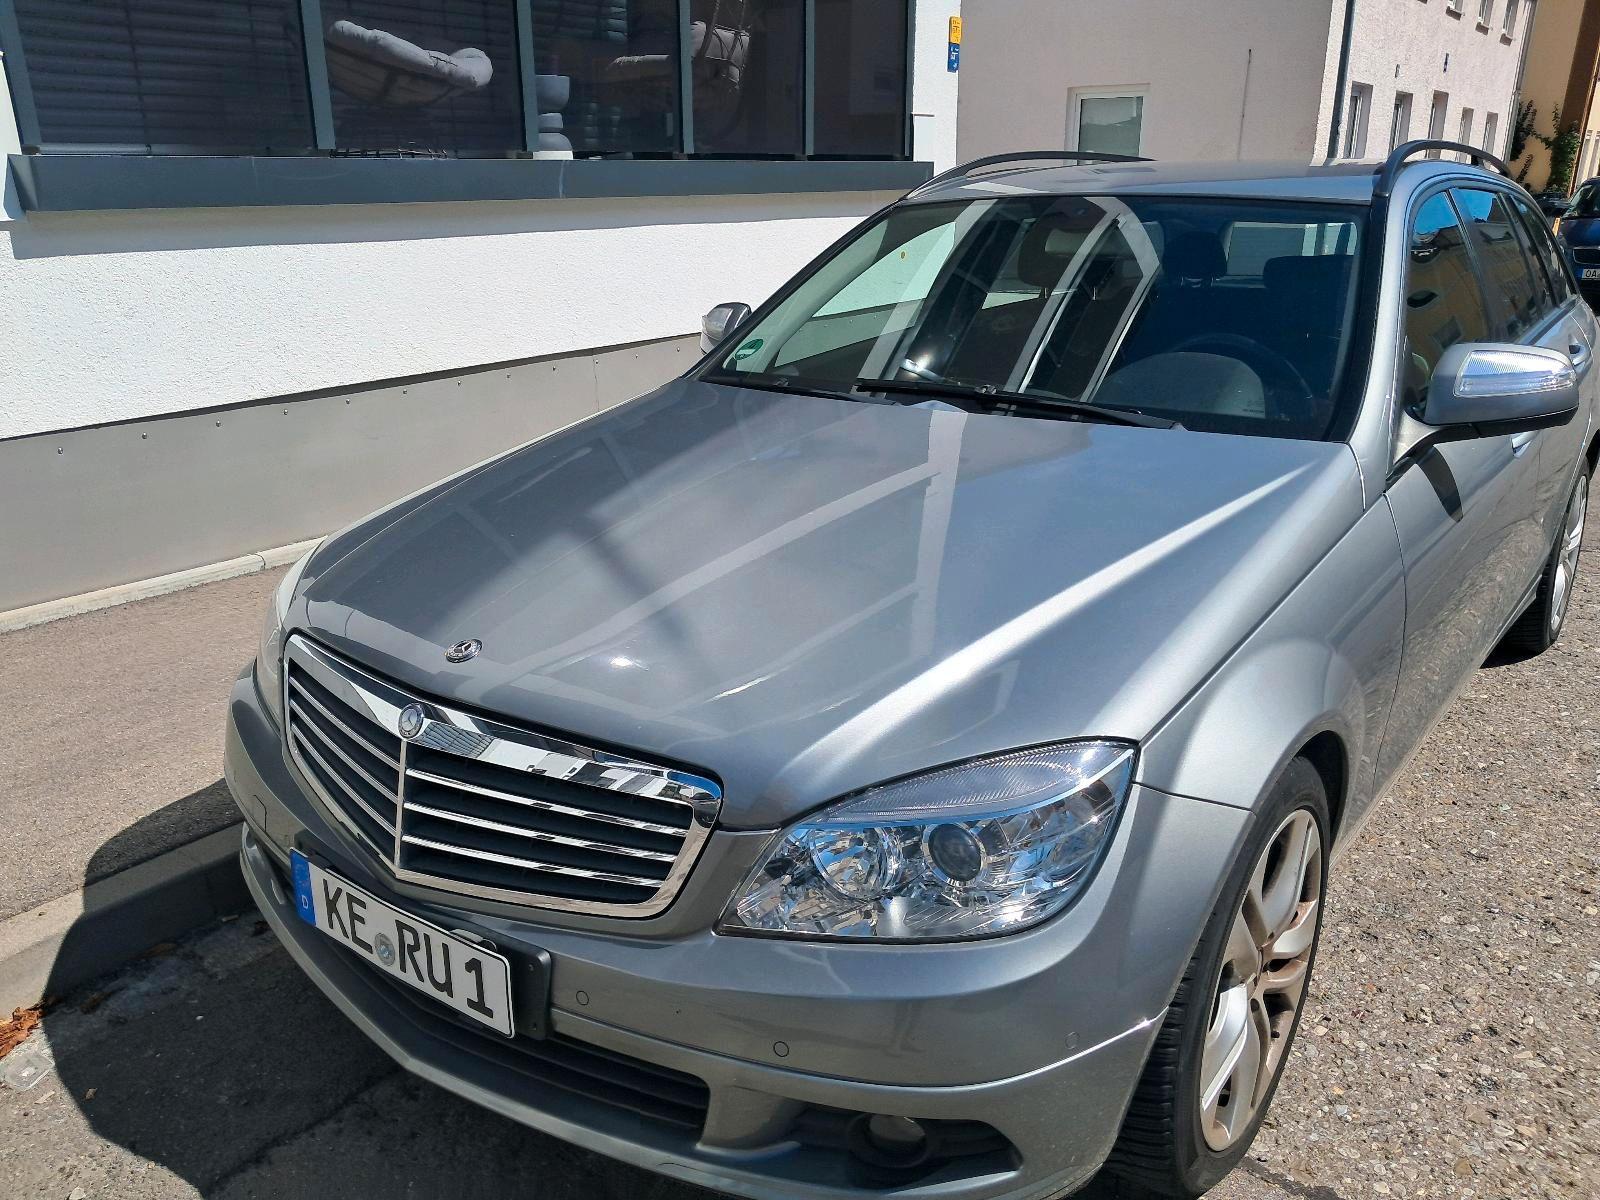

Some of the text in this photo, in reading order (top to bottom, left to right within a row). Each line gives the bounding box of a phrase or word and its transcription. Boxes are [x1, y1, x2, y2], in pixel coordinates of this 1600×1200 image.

[301, 895, 309, 910] D
[323, 878, 493, 1019] KE RU 1
